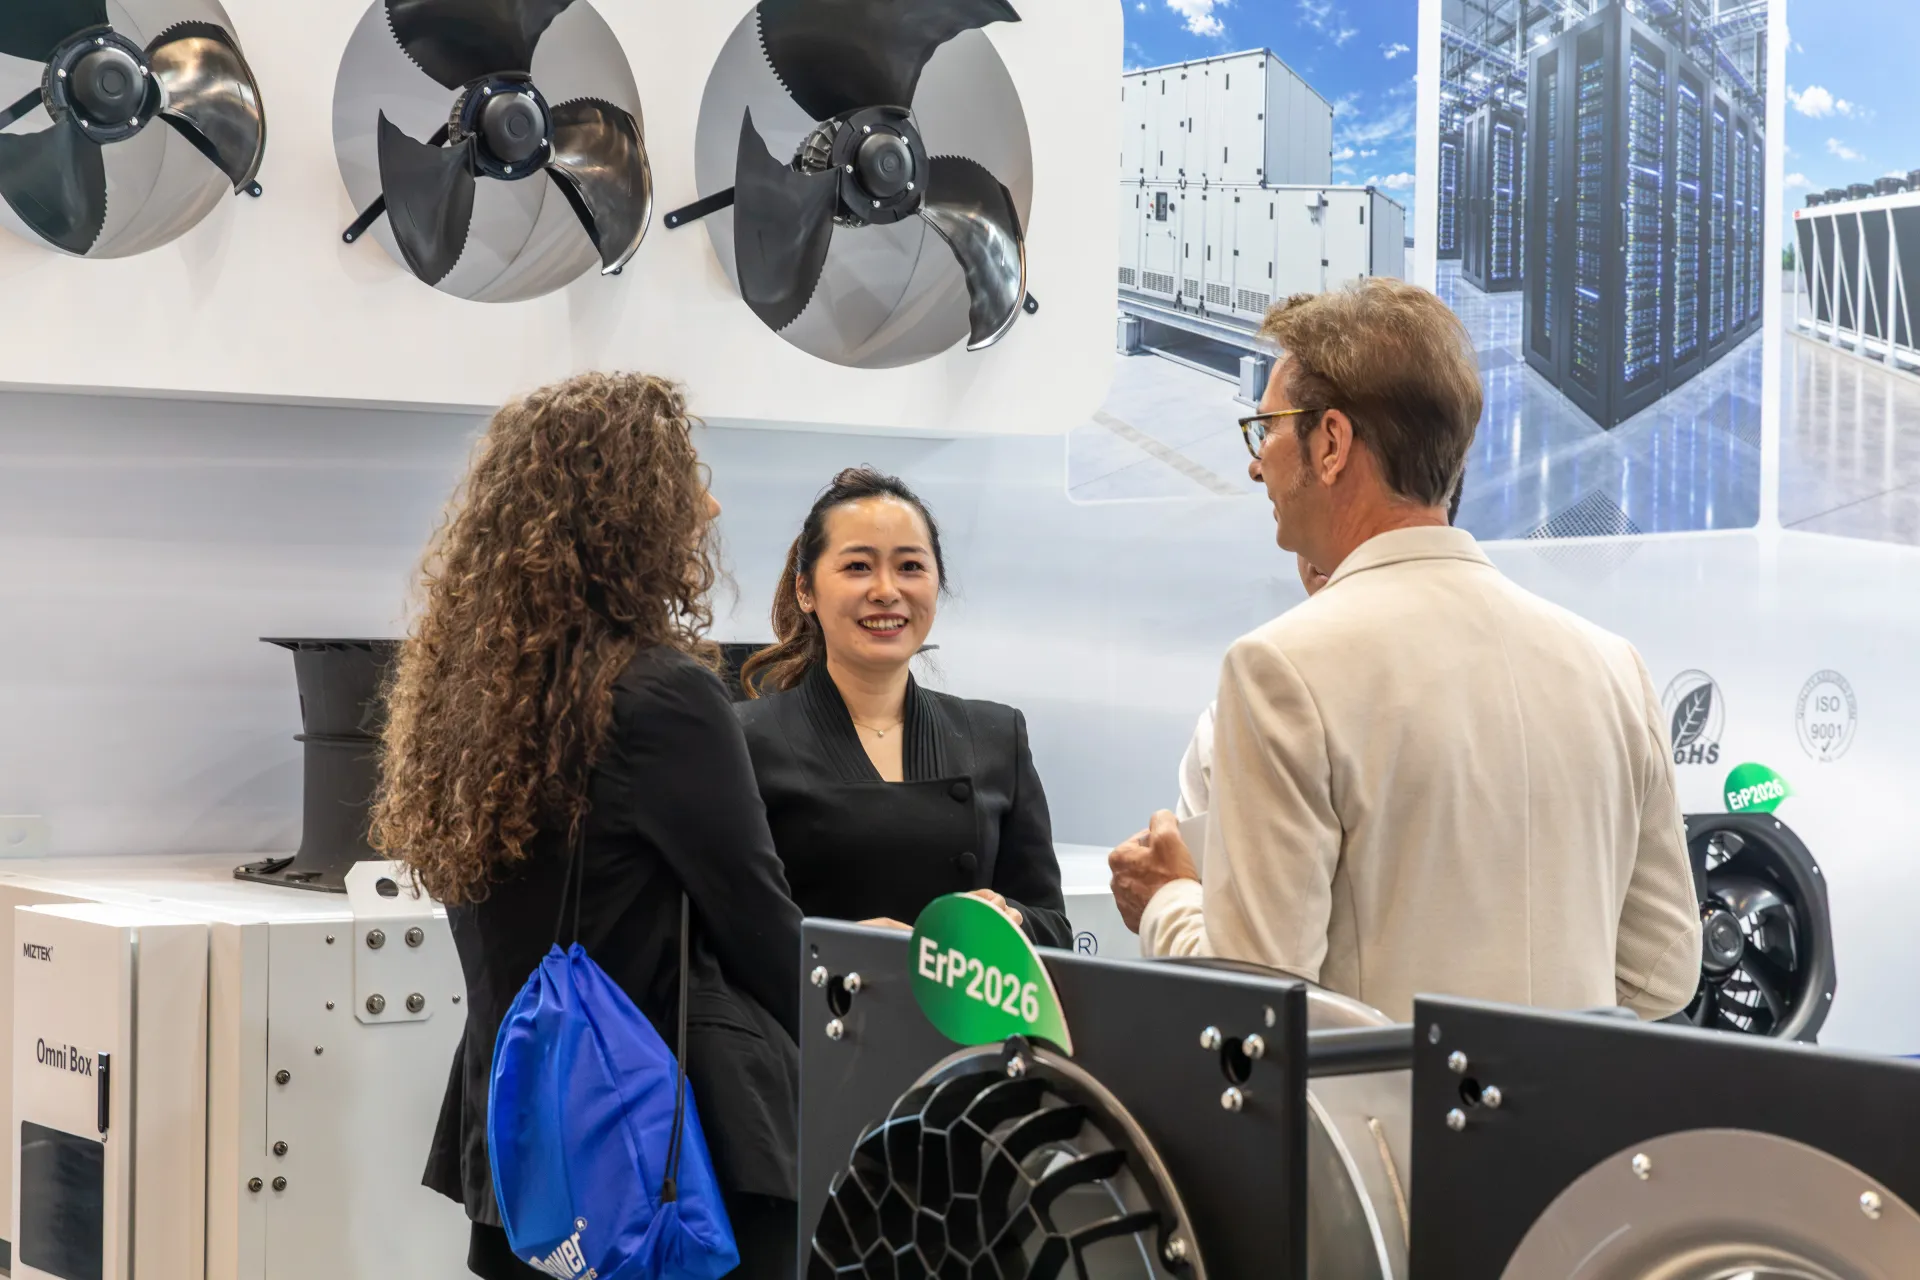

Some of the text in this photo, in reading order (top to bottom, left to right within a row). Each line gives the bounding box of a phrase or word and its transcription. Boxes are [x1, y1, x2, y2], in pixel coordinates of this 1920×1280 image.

[1815, 695, 1841, 713] ISO
[1810, 723, 1842, 740] 9001
[1672, 742, 1721, 765] oHS
[1726, 778, 1785, 811] ErP2026
[918, 935, 1040, 1024] ErP2026
[36, 1037, 93, 1077] Omni Box
